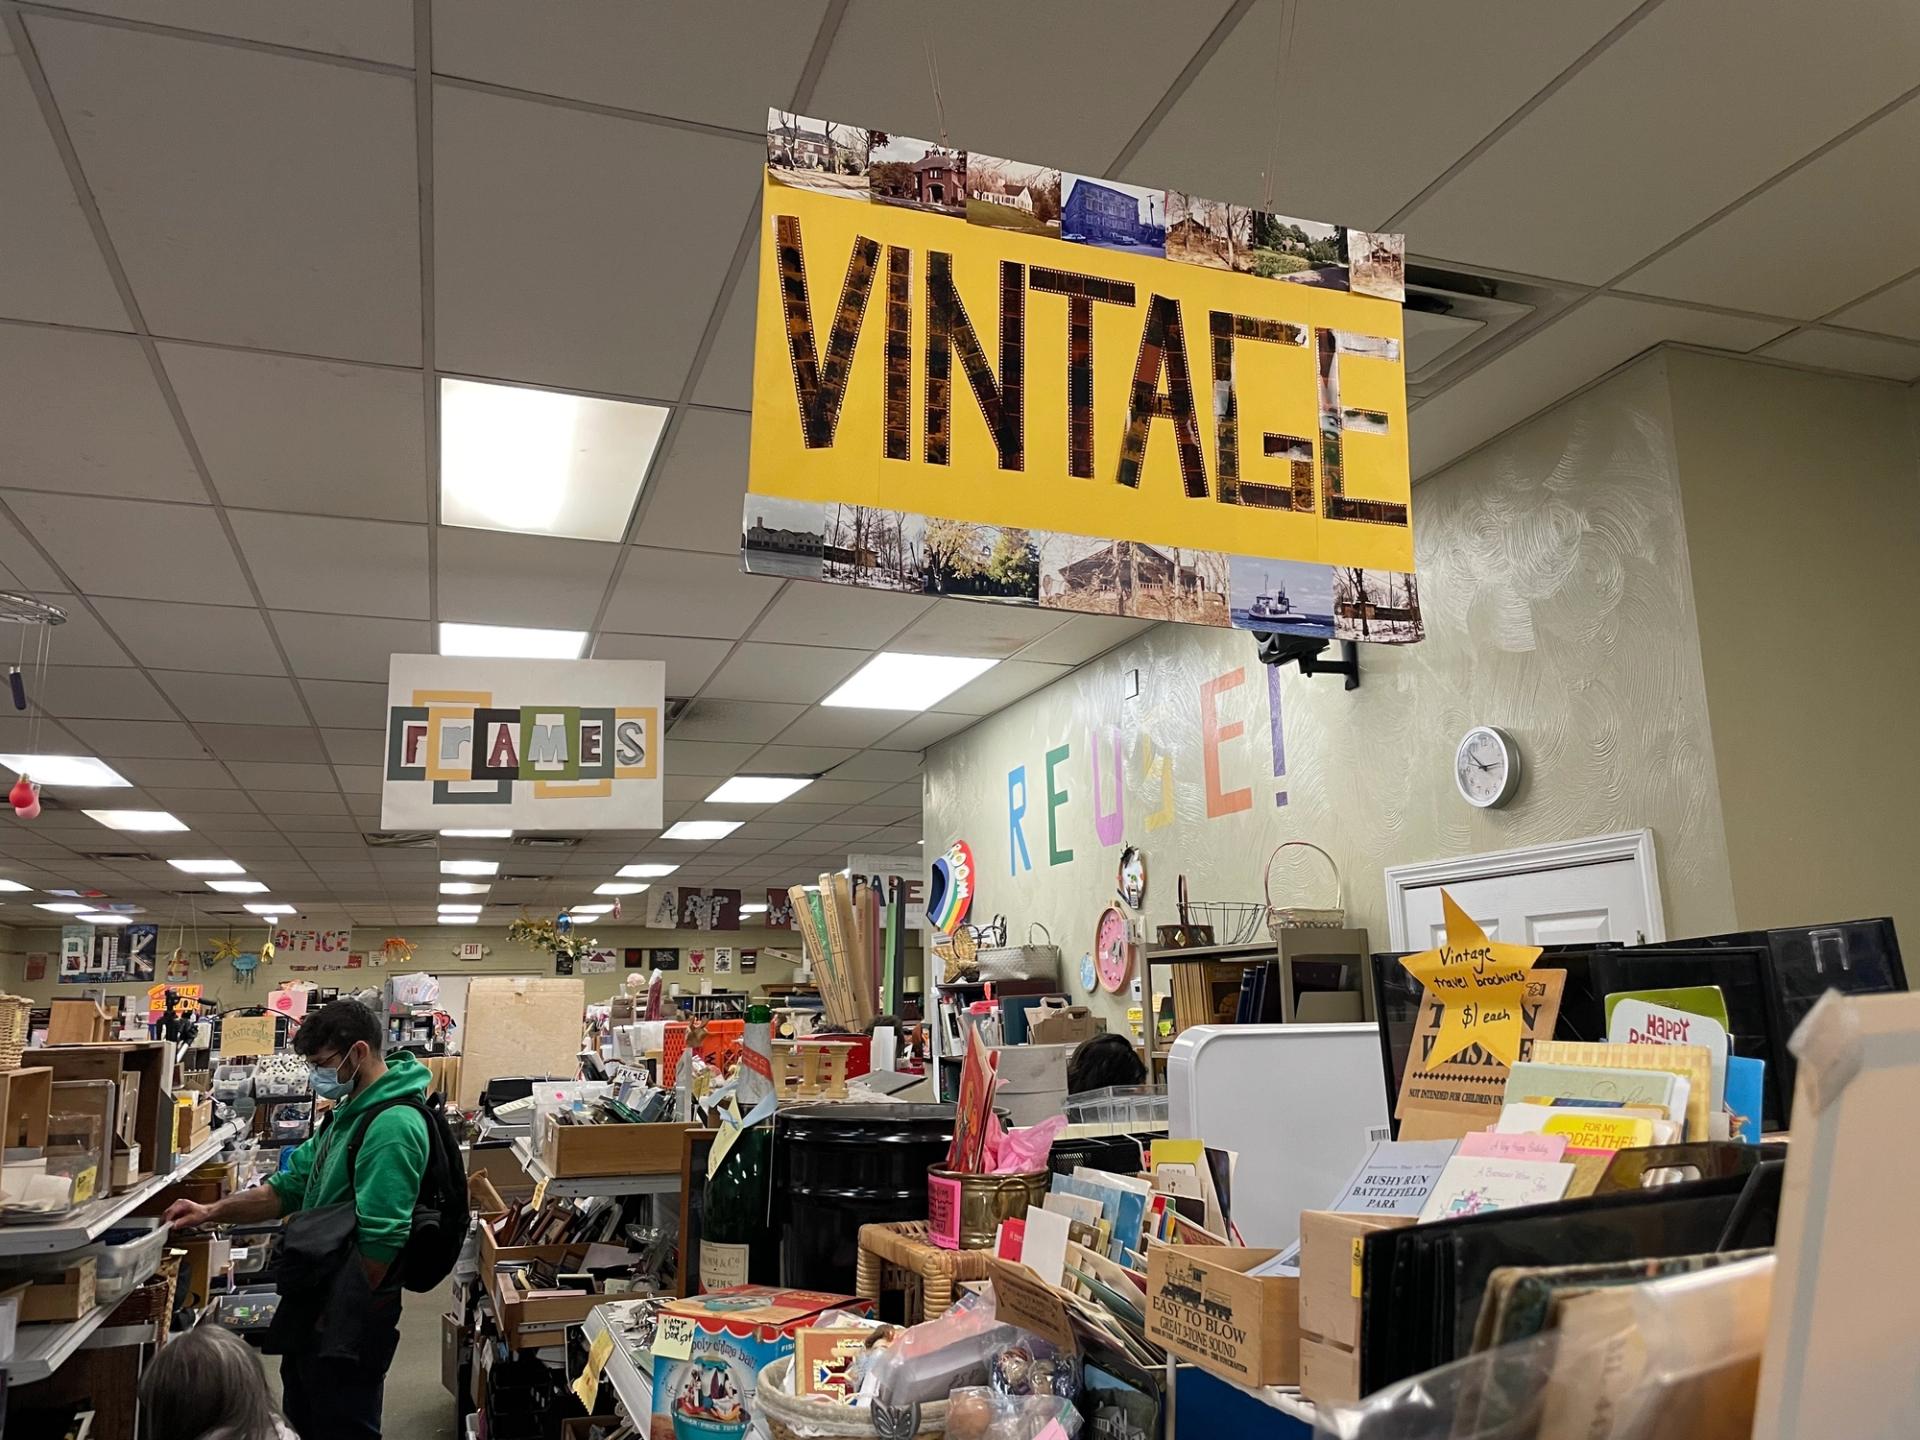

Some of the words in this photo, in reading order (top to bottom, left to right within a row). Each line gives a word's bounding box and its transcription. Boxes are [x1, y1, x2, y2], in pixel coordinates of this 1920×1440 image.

[773, 215, 1409, 527] VINTAGE
[1008, 663, 1289, 877] REUSE!
[274, 929, 350, 952] OFFICE
[464, 944, 479, 955] EXIT
[61, 933, 154, 976] BULK
[1439, 947, 1496, 974] Vintage
[1434, 976, 1469, 989] travel
[1475, 970, 1526, 988] brochures
[1483, 1008, 1511, 1023] each
[1420, 1089, 1448, 1100] INTENDED
[1448, 1091, 1460, 1101] FOR
[1461, 1092, 1493, 1104] CHILDREN
[1583, 1122, 1601, 1131] FOR
[1602, 1123, 1618, 1133] MY
[1363, 1175, 1404, 1185] BUSHY
[1404, 1175, 1430, 1185] RUN
[1352, 1187, 1428, 1197] BATTLEFIELD
[1366, 1199, 1398, 1208] PARK
[1153, 1296, 1182, 1318] EASY
[1184, 1308, 1202, 1327] TO
[1205, 1319, 1248, 1345] BLOW
[1160, 1316, 1182, 1335] GREAT
[1182, 1323, 1208, 1347] 3-TONE
[1208, 1334, 1237, 1359] SOUND
